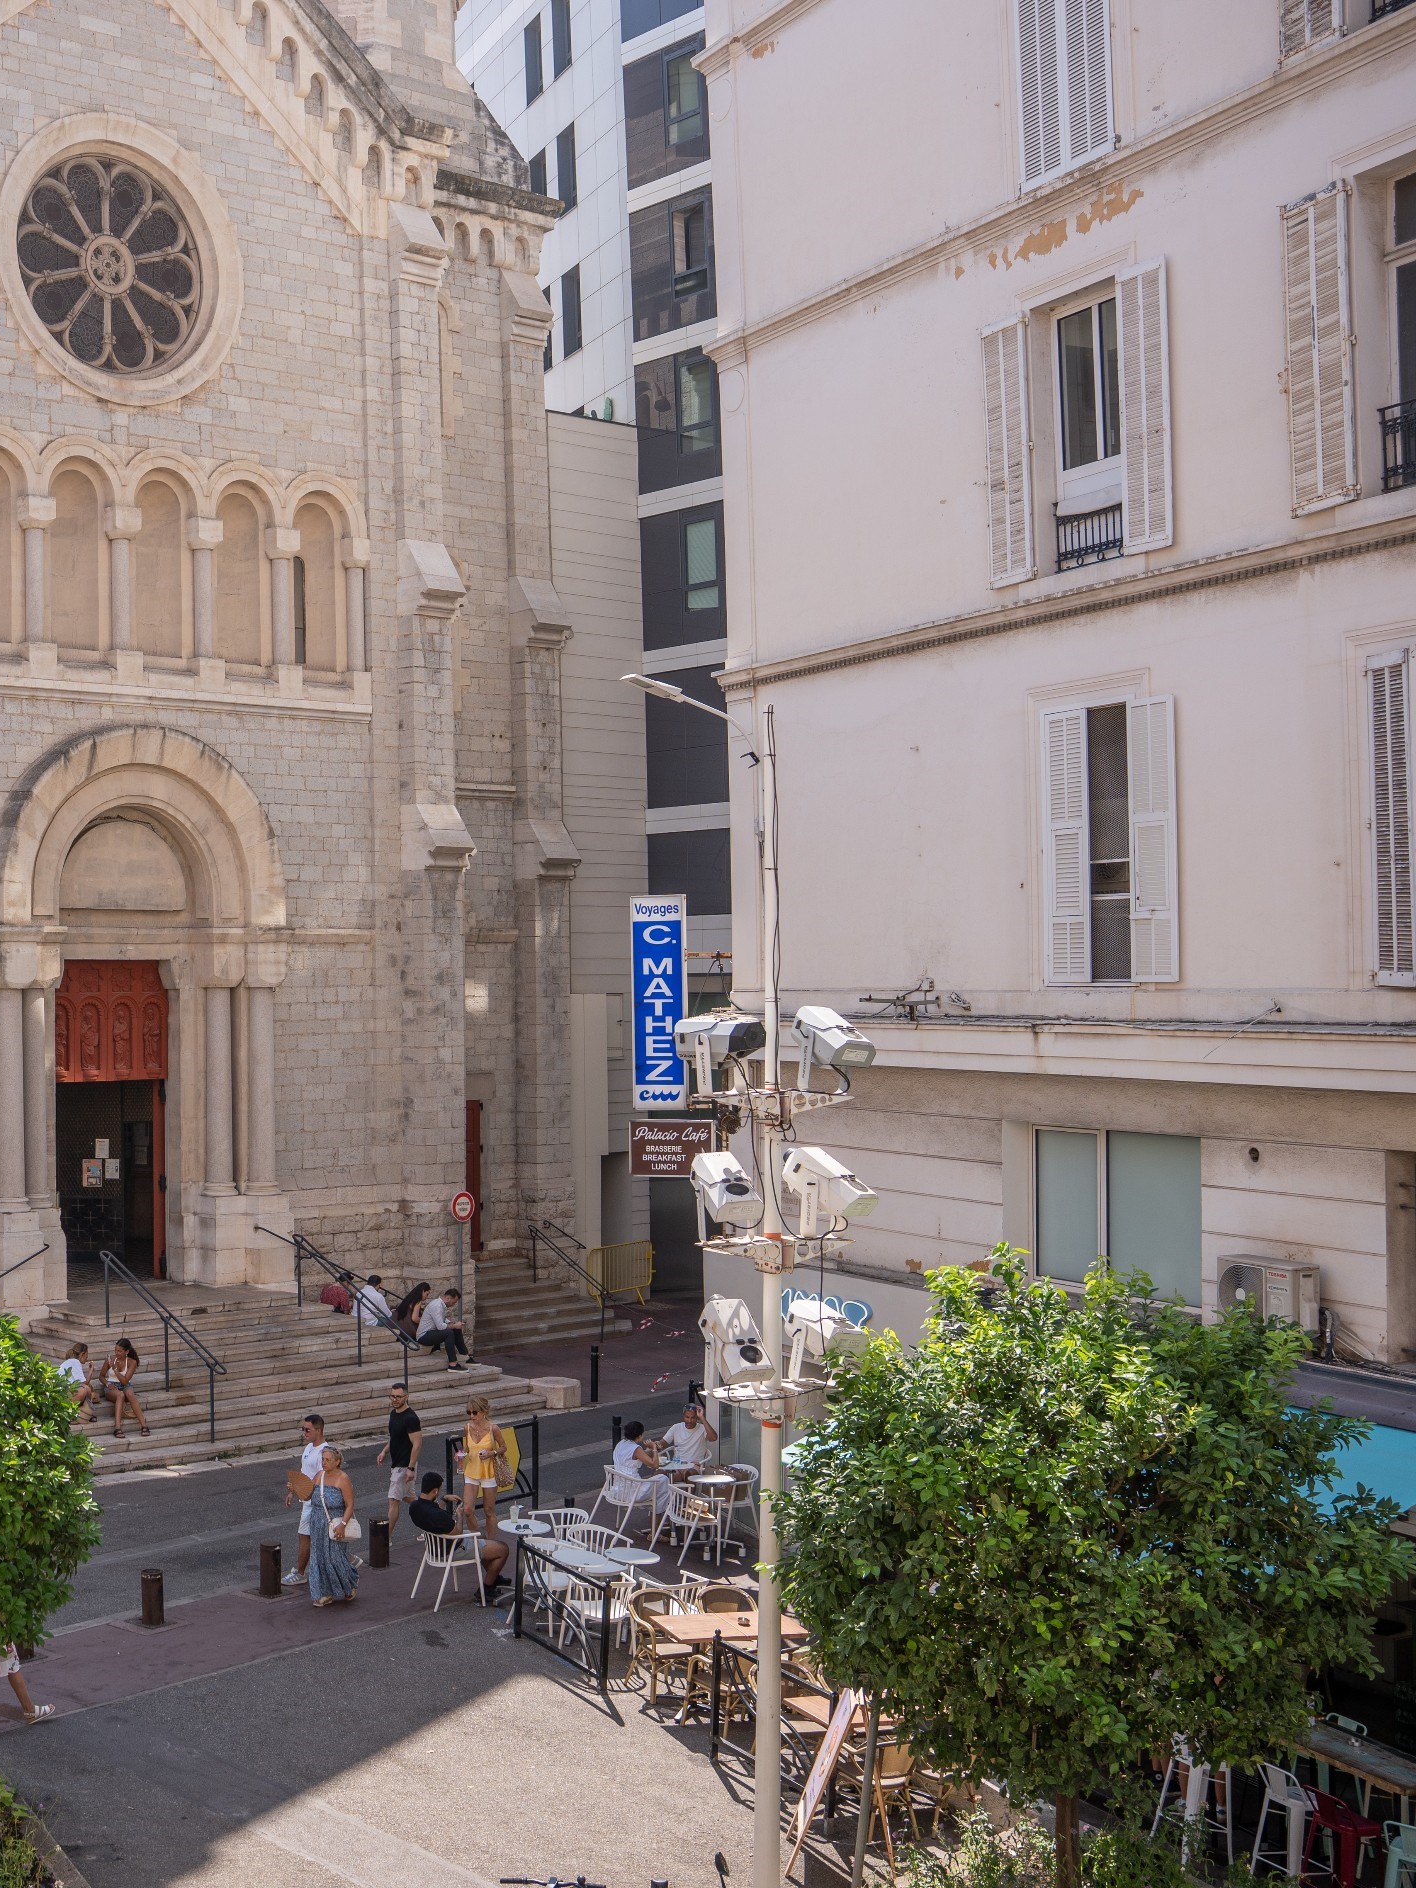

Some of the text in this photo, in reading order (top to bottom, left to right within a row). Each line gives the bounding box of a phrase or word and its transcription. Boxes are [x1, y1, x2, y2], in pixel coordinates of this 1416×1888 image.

[634, 903, 679, 917] Voyages
[642, 957, 674, 1081] MATHEZ
[633, 1126, 709, 1143] Palacio Café
[1268, 1271, 1287, 1279] TOSHIBA
